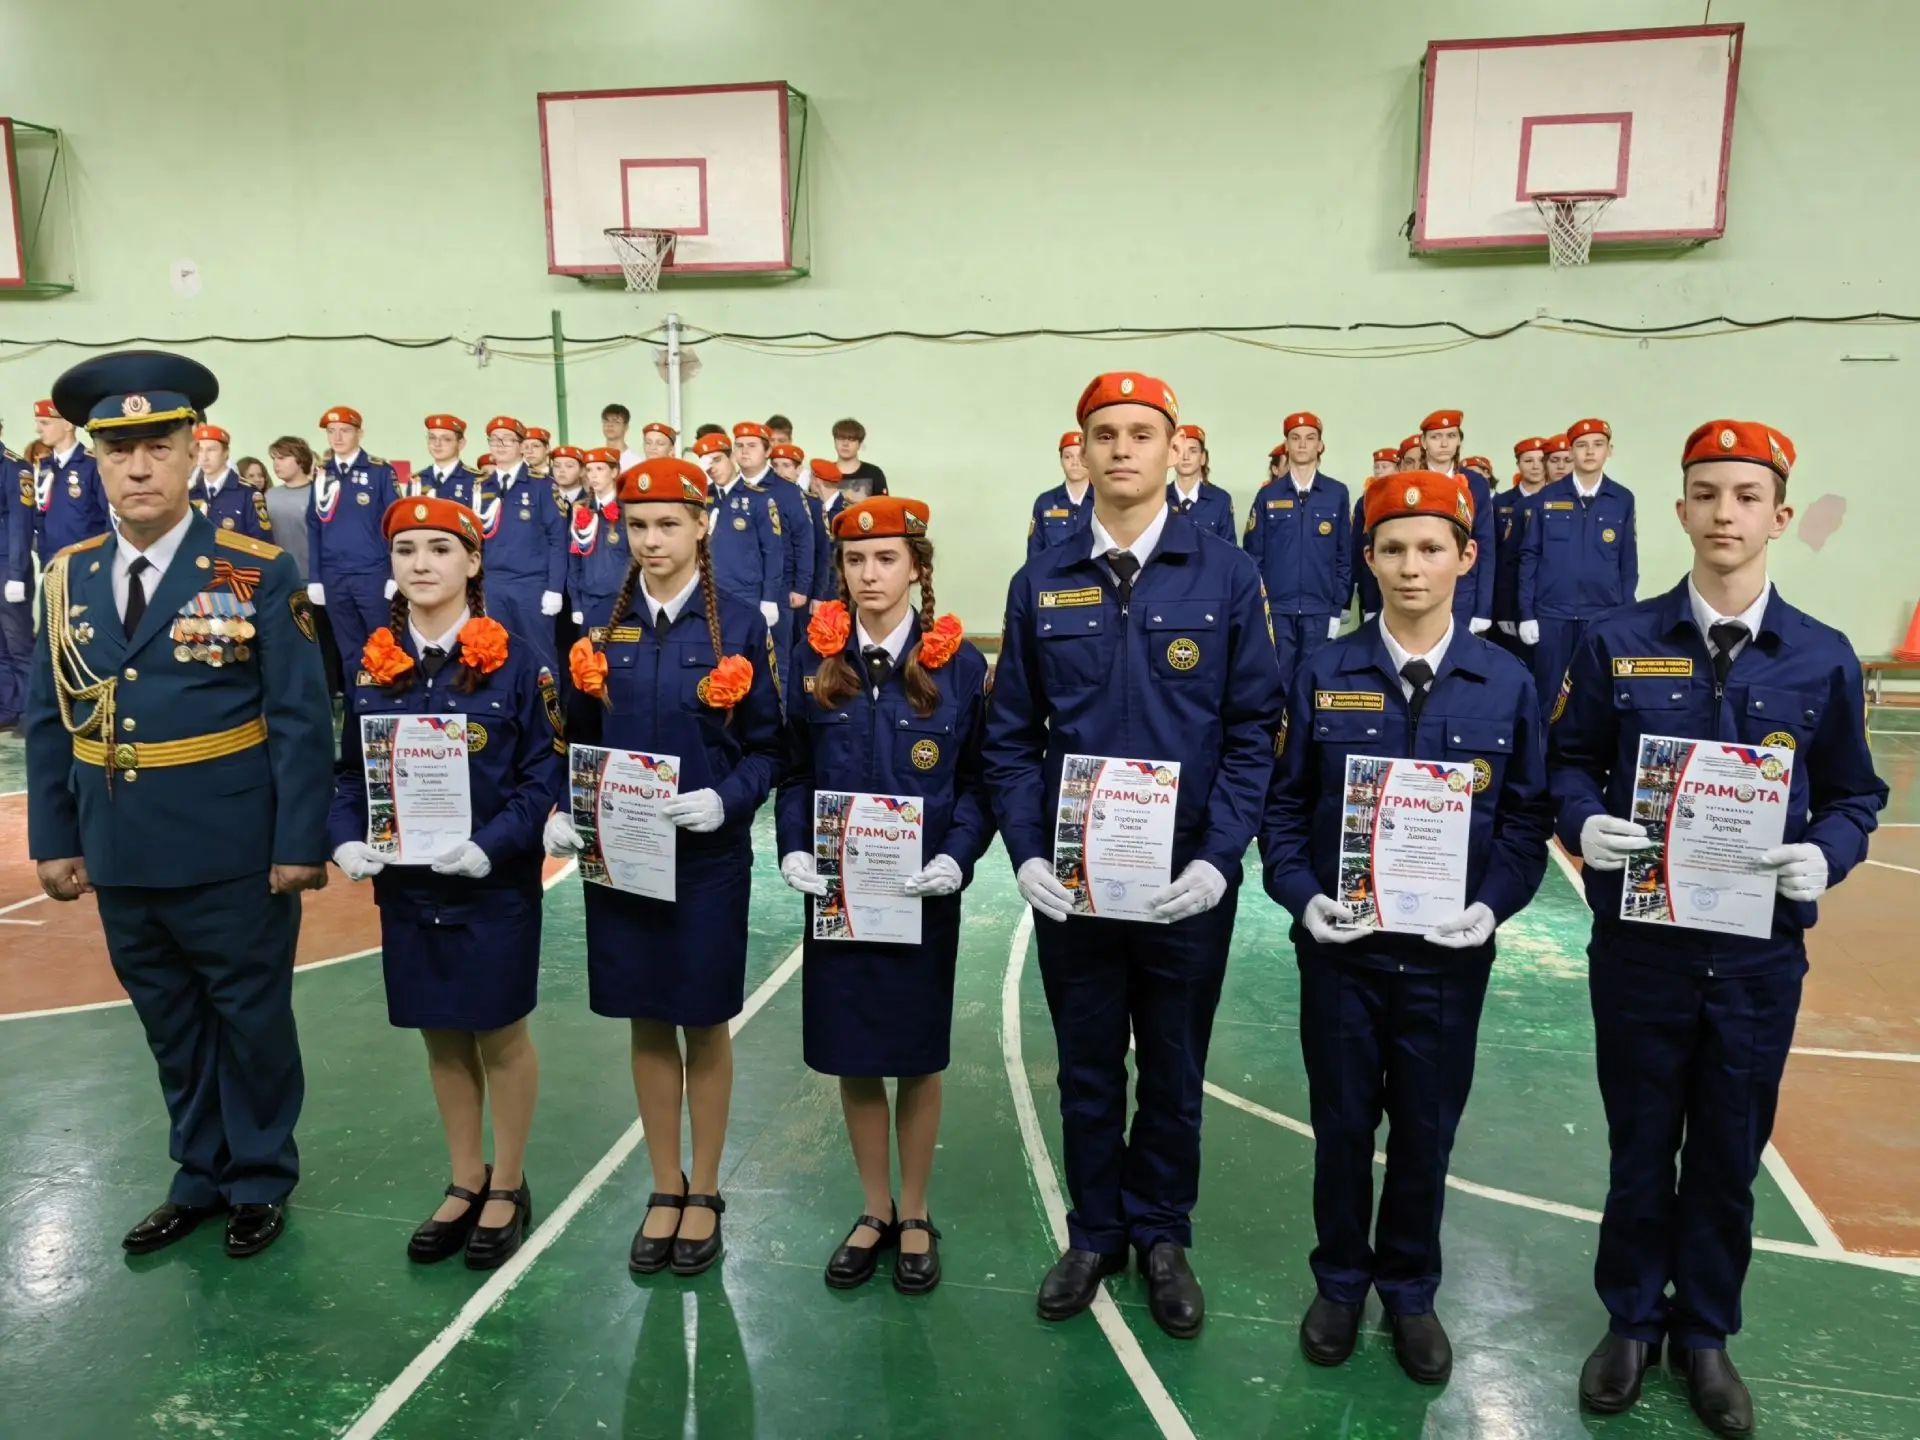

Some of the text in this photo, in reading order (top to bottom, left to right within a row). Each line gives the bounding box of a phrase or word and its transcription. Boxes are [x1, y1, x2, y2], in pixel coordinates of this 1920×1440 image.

[397, 745, 463, 760] ГРАМОТА
[603, 781, 672, 800] ГРАМОТА
[1097, 788, 1171, 805] ГРАМОТА
[1683, 780, 1781, 804] ГРАМОТА
[1384, 795, 1465, 814] ГРАМОТА
[848, 826, 917, 841] ГРАМОТА
